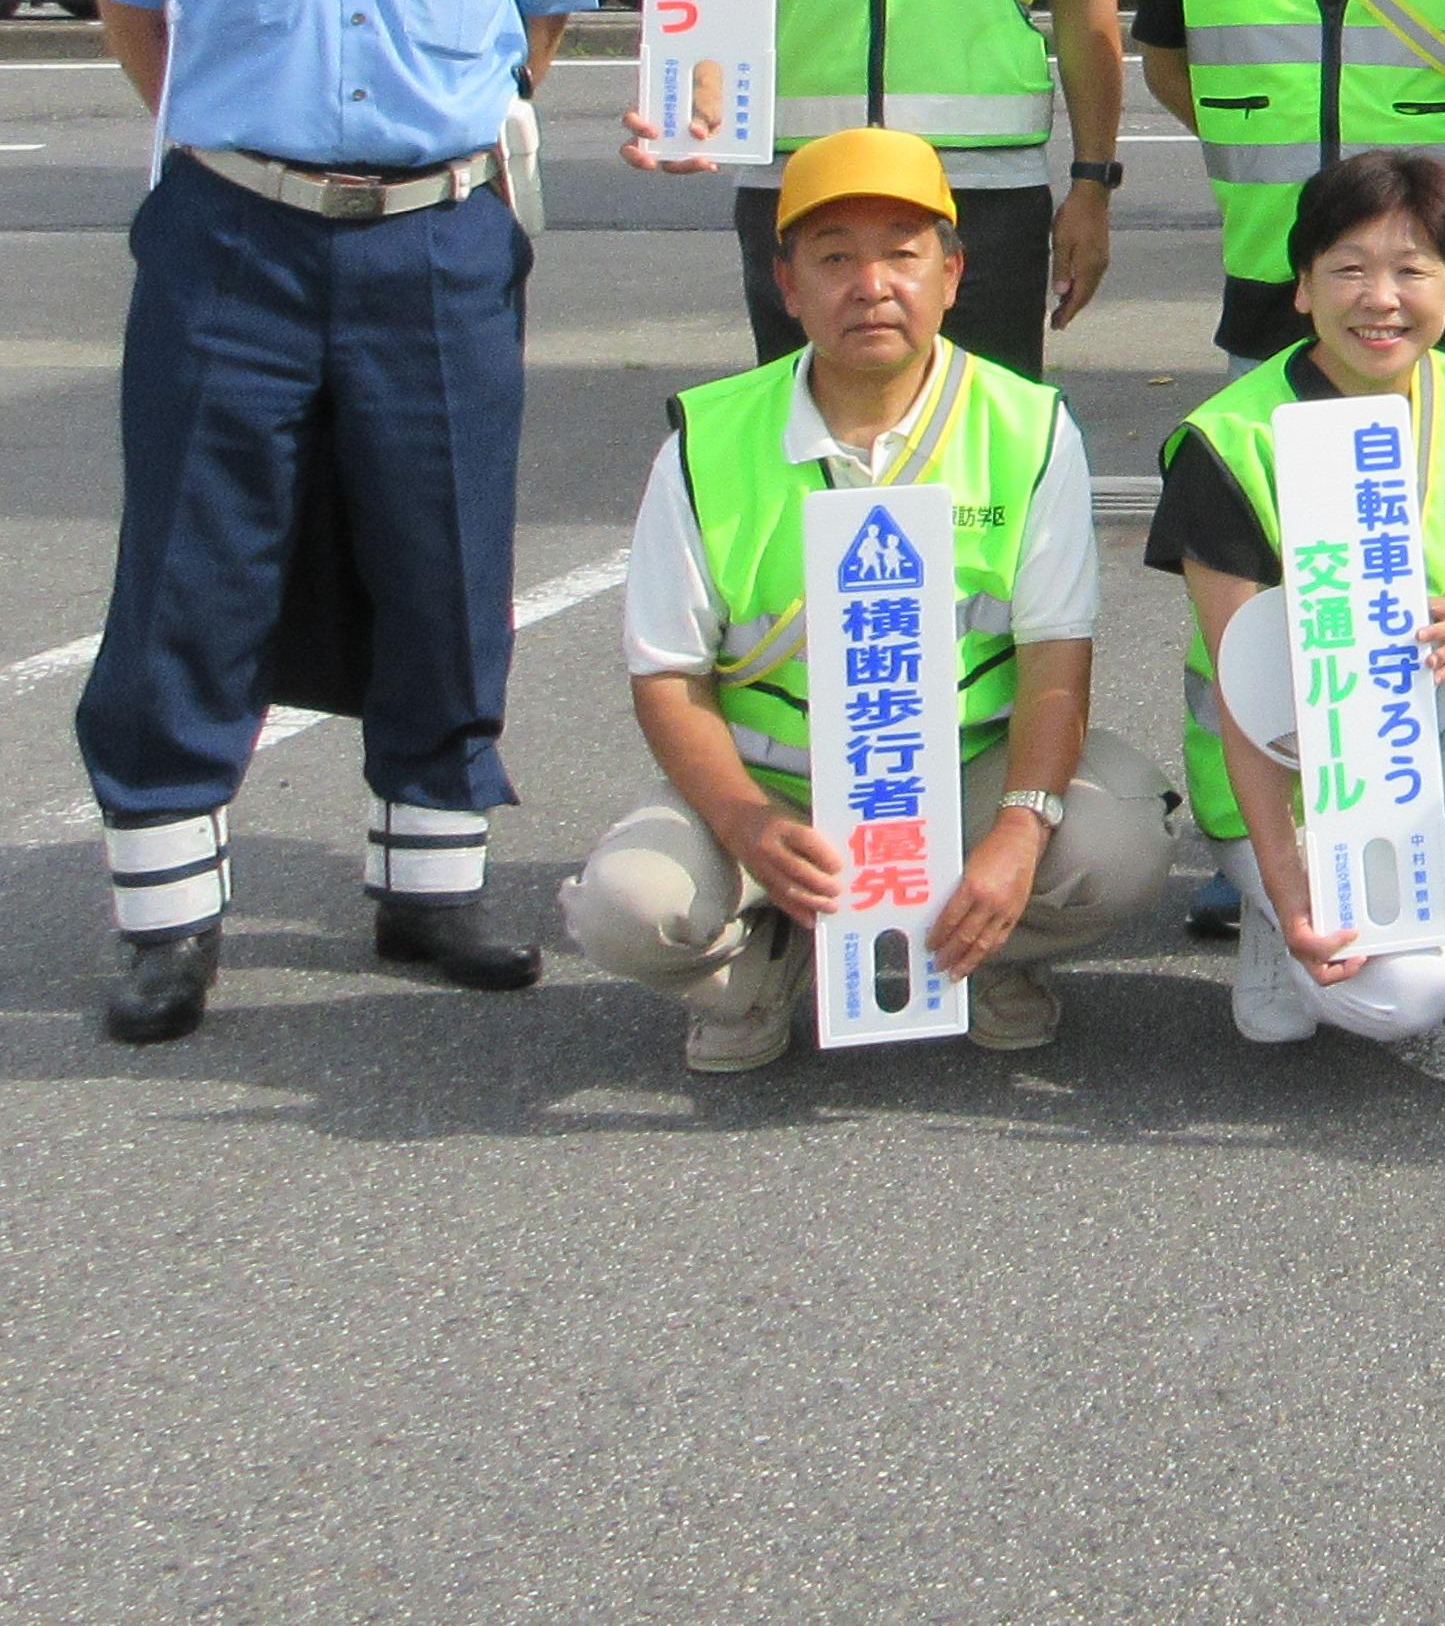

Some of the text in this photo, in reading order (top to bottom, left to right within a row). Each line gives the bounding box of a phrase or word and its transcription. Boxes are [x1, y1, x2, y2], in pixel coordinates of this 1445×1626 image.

[842, 597, 930, 912] 横断歩行者優先
[1296, 541, 1366, 814] 交通ルール
[1354, 423, 1421, 805] 自転車も守ろう
